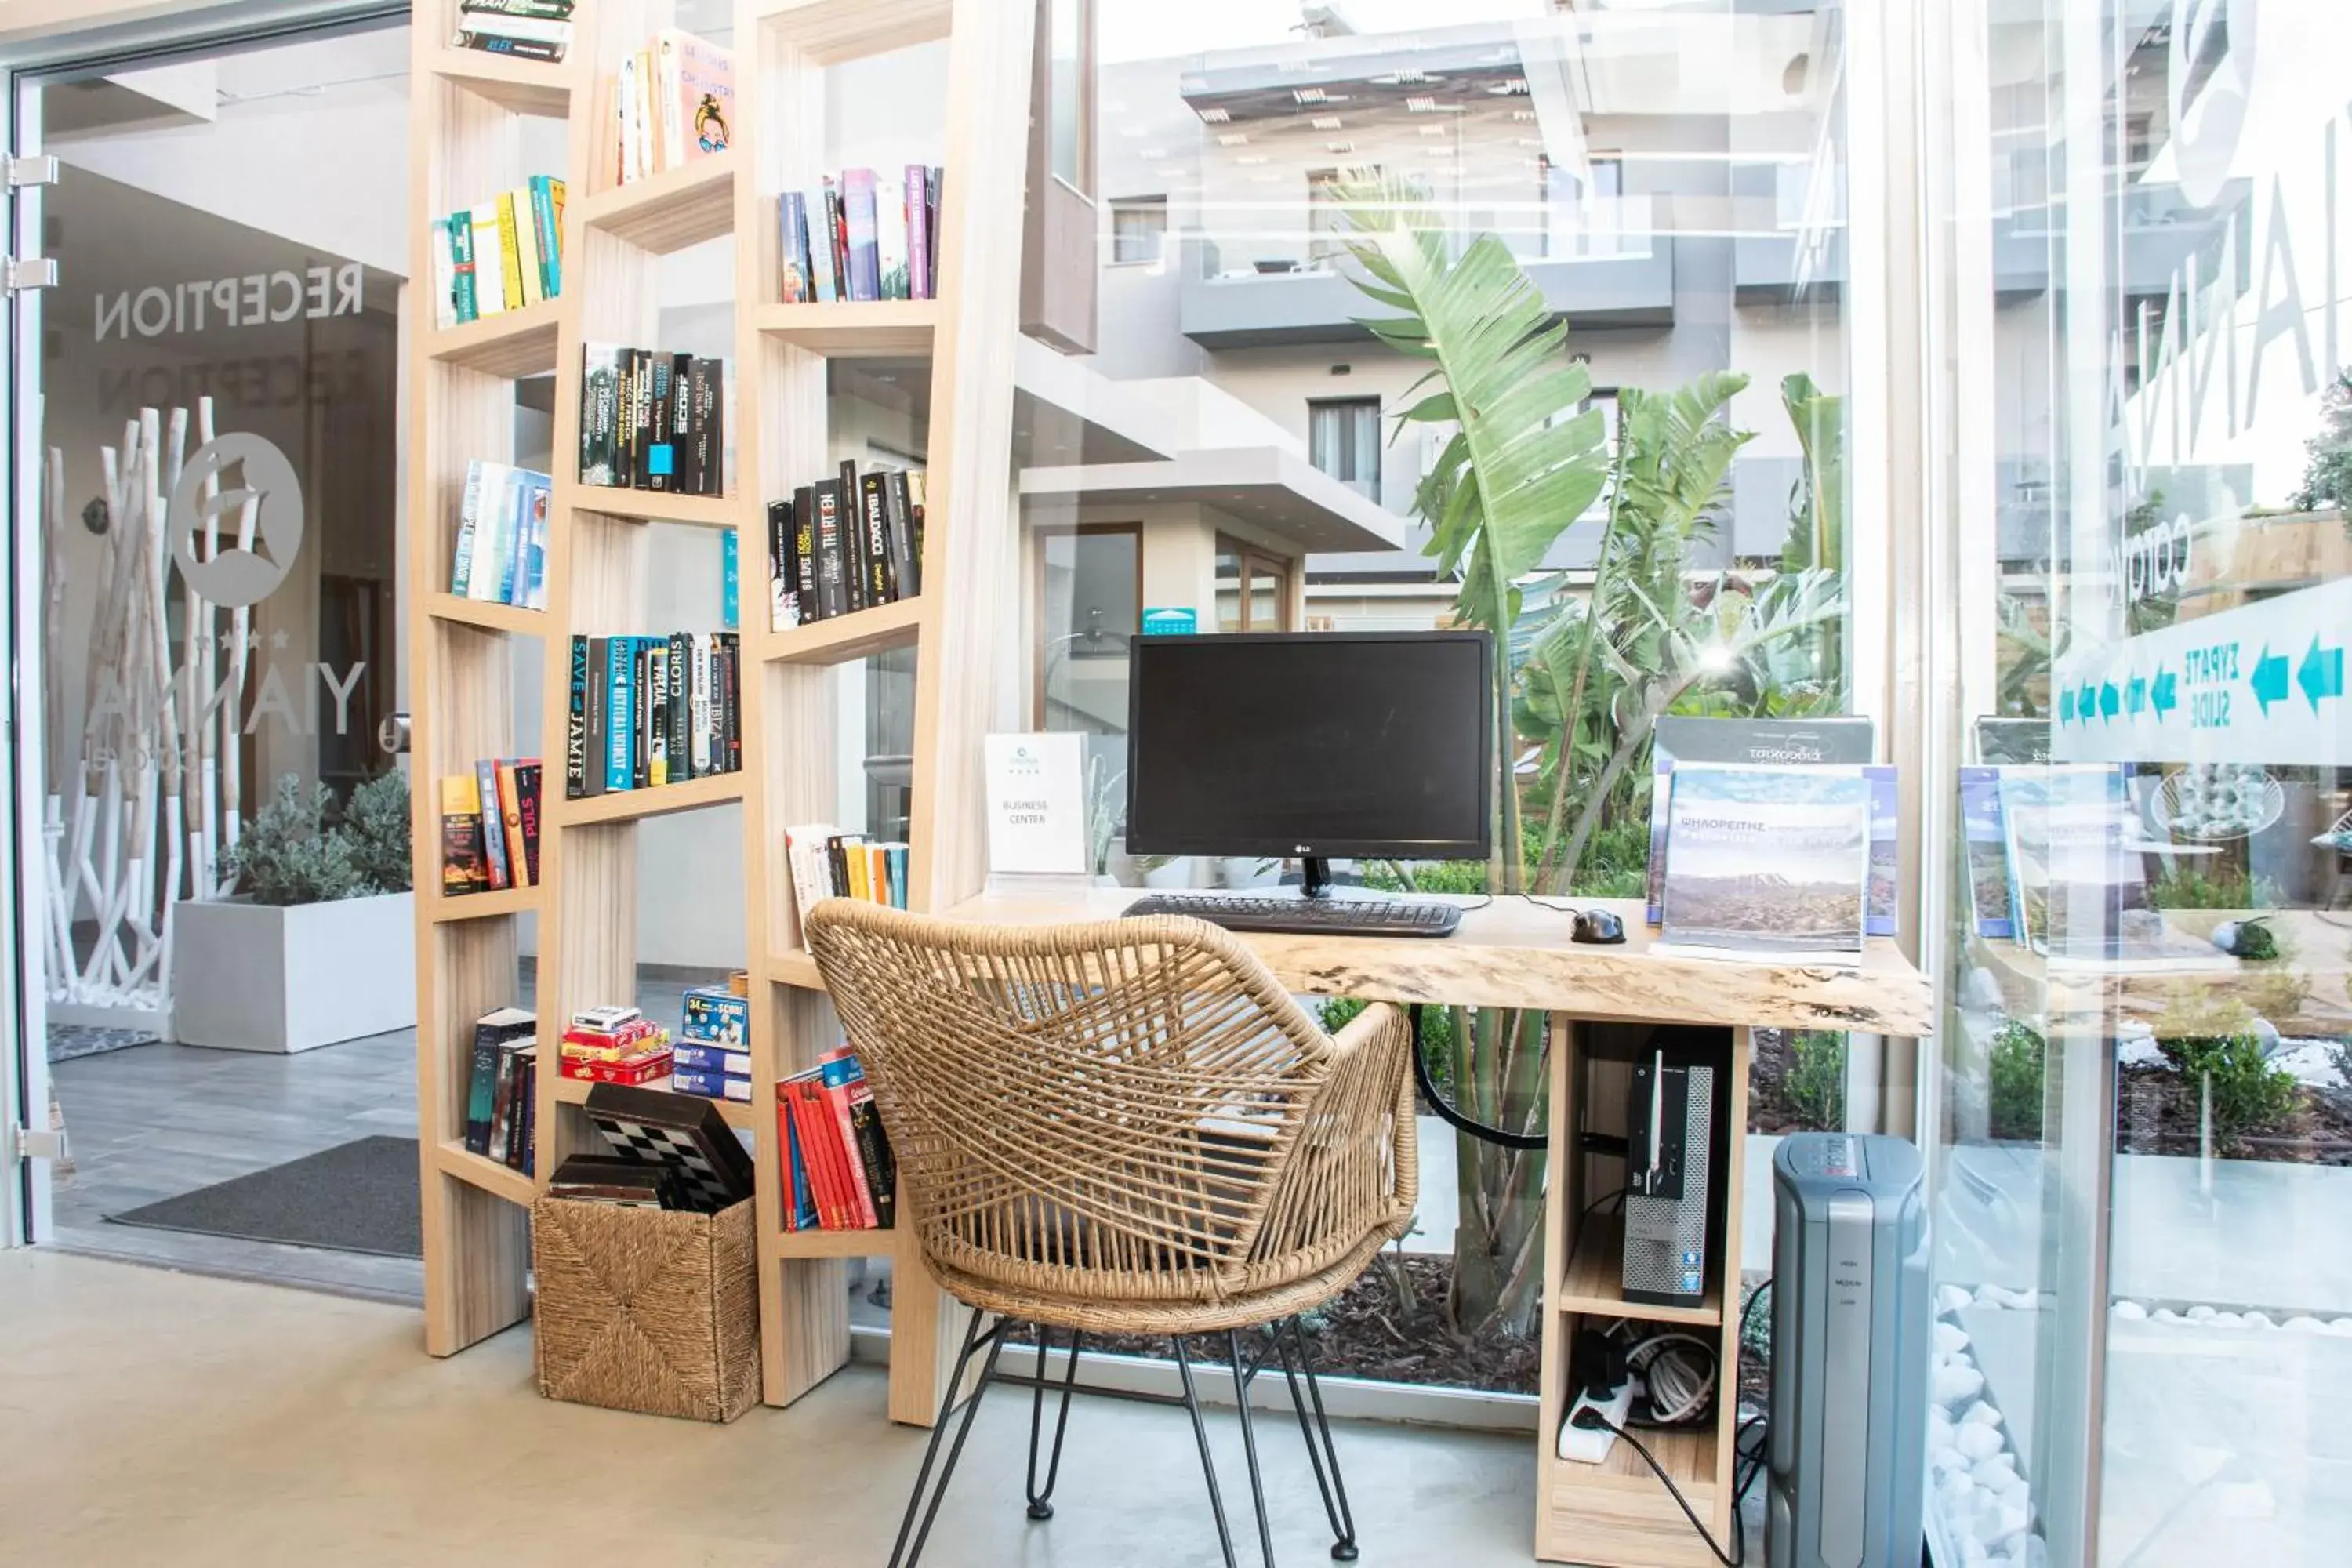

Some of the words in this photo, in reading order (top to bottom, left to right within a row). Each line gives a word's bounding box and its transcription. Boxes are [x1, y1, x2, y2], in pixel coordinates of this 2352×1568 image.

[573, 640, 586, 693] SAVE
[671, 641, 682, 696] CLORIS
[711, 704, 721, 740] IBIZA
[569, 713, 583, 778] JAMIE
[1003, 800, 1048, 811] BUSINESS
[1009, 815, 1047, 825] CENTER
